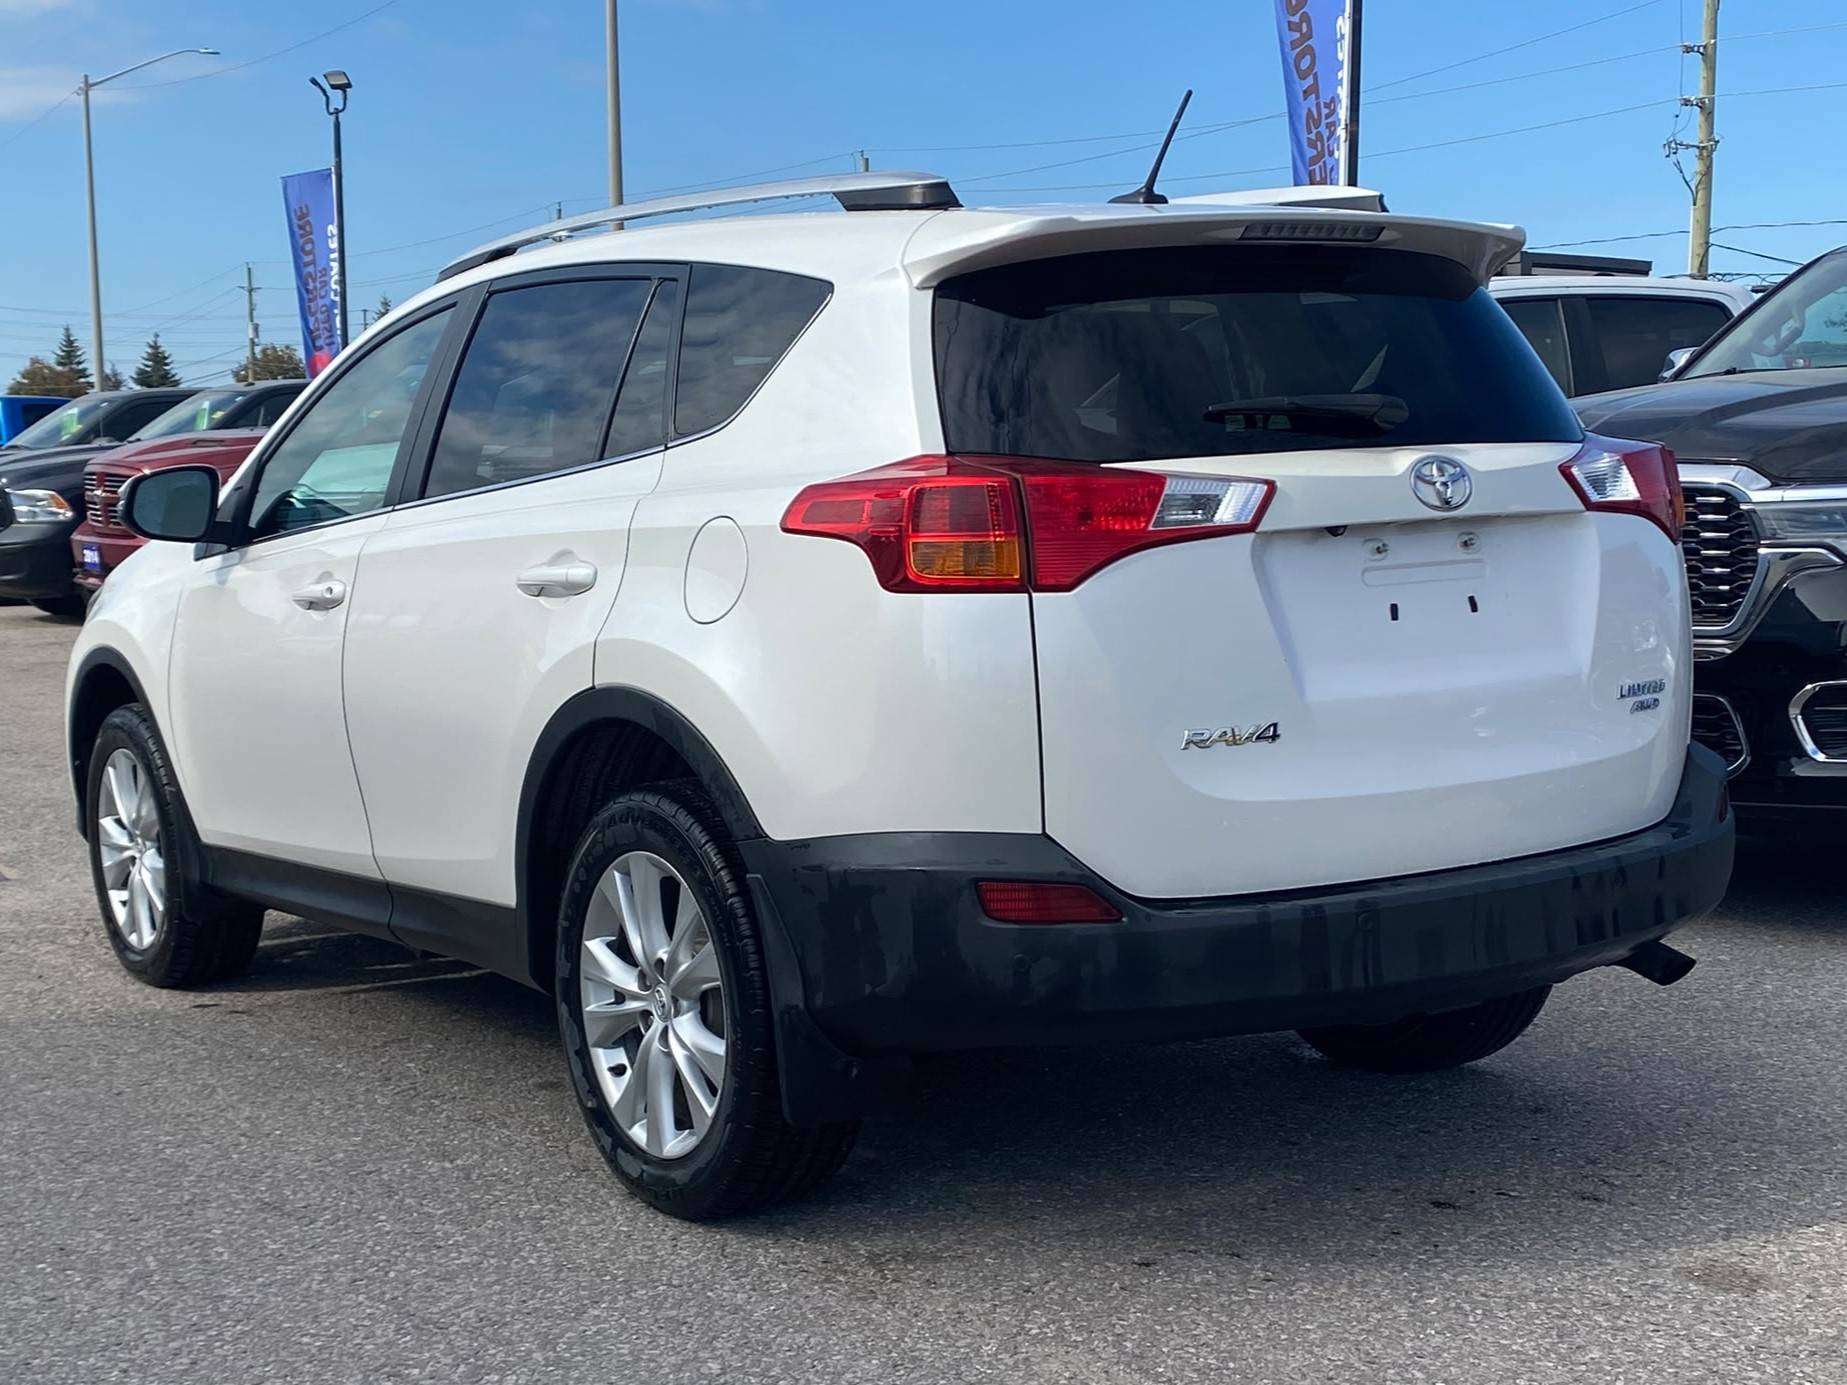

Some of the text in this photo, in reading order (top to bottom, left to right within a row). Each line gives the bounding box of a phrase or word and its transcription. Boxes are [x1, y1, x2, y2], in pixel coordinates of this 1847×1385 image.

[1616, 678, 1666, 700] LIMITED
[1629, 697, 1661, 714] AWD
[1179, 720, 1282, 751] RAV4
